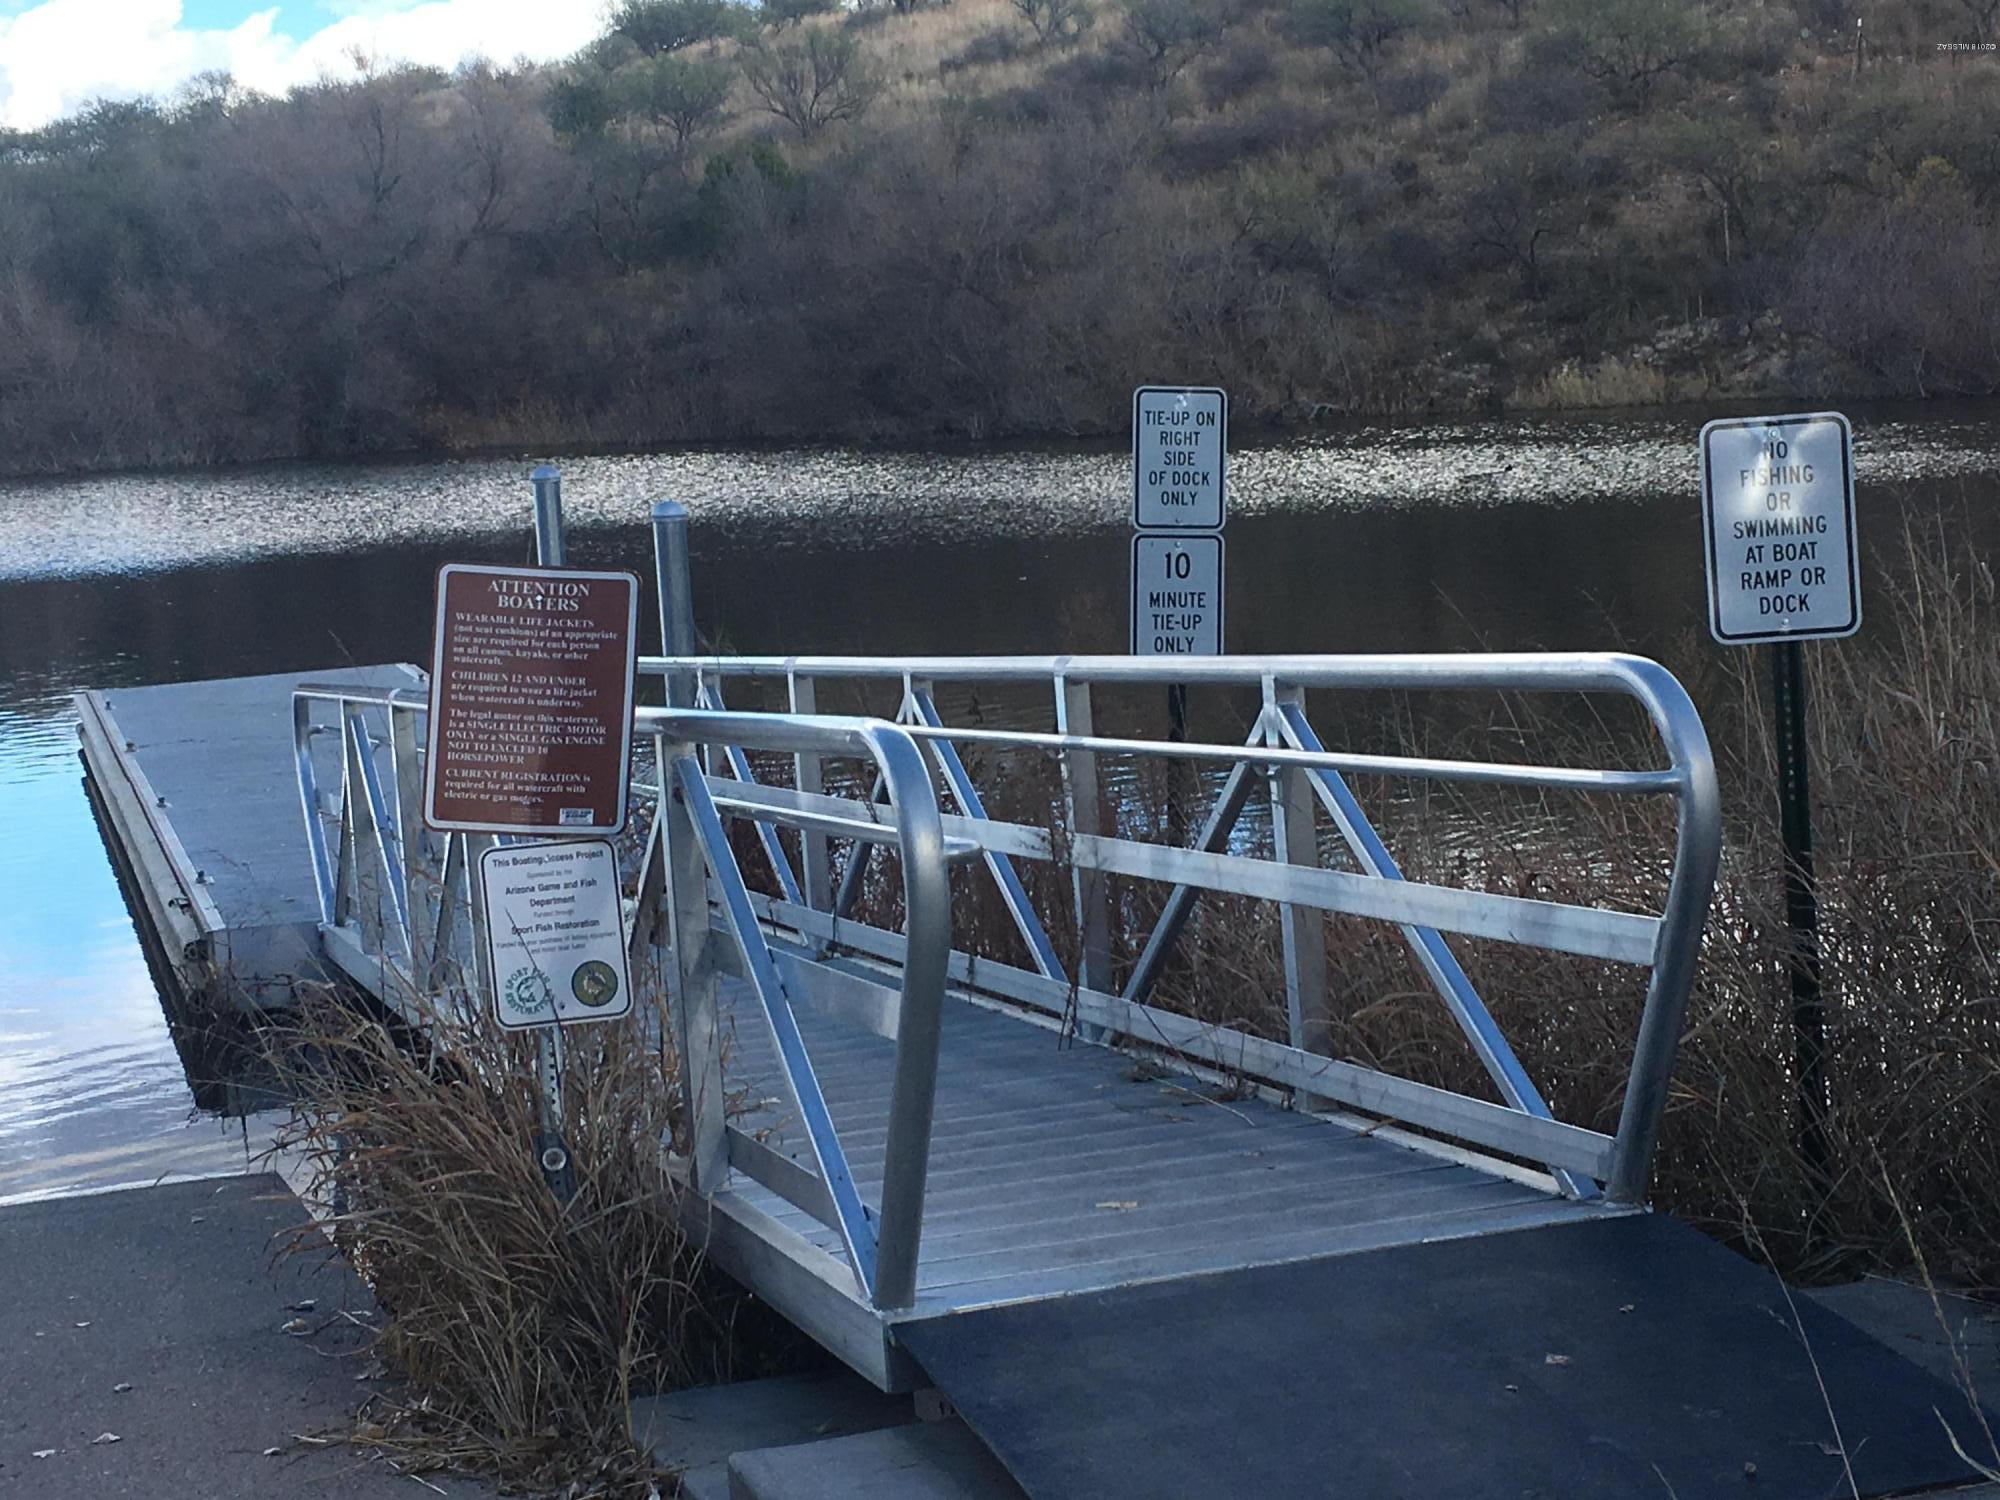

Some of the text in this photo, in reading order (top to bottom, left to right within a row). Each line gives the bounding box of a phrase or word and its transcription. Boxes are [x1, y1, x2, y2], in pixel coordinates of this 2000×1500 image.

[1144, 410, 1215, 426] TIE-UP ON
[1159, 431, 1200, 446] RIGHT
[1764, 441, 1788, 459] NO
[1164, 452, 1195, 466] SIDE
[1149, 471, 1210, 486] OF DOCK
[1739, 464, 1814, 488] FISHING
[1161, 492, 1197, 506] ONLY
[1766, 492, 1791, 511] OR
[1733, 515, 1827, 539] SWIMMING
[1746, 541, 1818, 564] AT BOAT
[1164, 552, 1190, 579] 10
[1741, 567, 1826, 590] RAMP OR
[488, 579, 590, 596] ATTENTION
[498, 595, 579, 611] BOATERS
[1149, 592, 1206, 608] MINUTE
[1760, 594, 1810, 615] DOCK
[456, 612, 594, 628] WEARABLE LIFE JACKETS
[1152, 614, 1202, 631] TIE-UP
[454, 624, 473, 632] (not
[475, 626, 493, 634] seat
[495, 626, 538, 637] cushions)
[565, 630, 618, 640] appropriate
[490, 637, 528, 646] required
[531, 639, 544, 647] for
[547, 640, 568, 649] each
[570, 642, 600, 651] person
[1154, 636, 1194, 653] ONLY
[453, 656, 503, 665] watercraft.
[467, 646, 479, 654] all
[516, 649, 550, 660] kayaks,
[564, 652, 588, 660] other
[451, 671, 586, 686] CHILDREN 12 AND UNDER
[468, 684, 507, 693] required
[510, 685, 519, 693] to
[521, 687, 544, 695] wear
[553, 688, 568, 696] life
[569, 688, 598, 698] jacket
[451, 693, 583, 709] when watercraft is underway.
[449, 708, 468, 717] The
[470, 710, 491, 720] legal
[493, 712, 521, 720] motor
[537, 714, 554, 722] this
[556, 716, 598, 725] waterway
[467, 720, 506, 730] SINGLE
[509, 722, 563, 733] ELECTRIC
[567, 725, 607, 735] MOTOR
[446, 730, 475, 739] ONLY
[498, 733, 538, 743] SINGLE
[541, 736, 562, 744] GAS
[565, 736, 605, 745] ENGINE
[448, 741, 548, 754] NOT TO EXCEED 10
[447, 752, 524, 764] HORSEPOWER
[445, 768, 499, 779] CURRENT
[501, 772, 581, 782] REGISTRATION
[444, 789, 477, 799] electric
[445, 780, 484, 788] required
[487, 782, 500, 790] for
[517, 784, 563, 793] watercraft
[565, 785, 586, 793] with
[493, 859, 510, 867] This
[512, 856, 542, 866] Boating
[576, 850, 604, 860] Project
[505, 878, 597, 895] Arizona Game and Fish
[530, 896, 576, 907] Department
[511, 919, 600, 935] Sport Fish Restoration
[506, 967, 528, 989] SPORT
